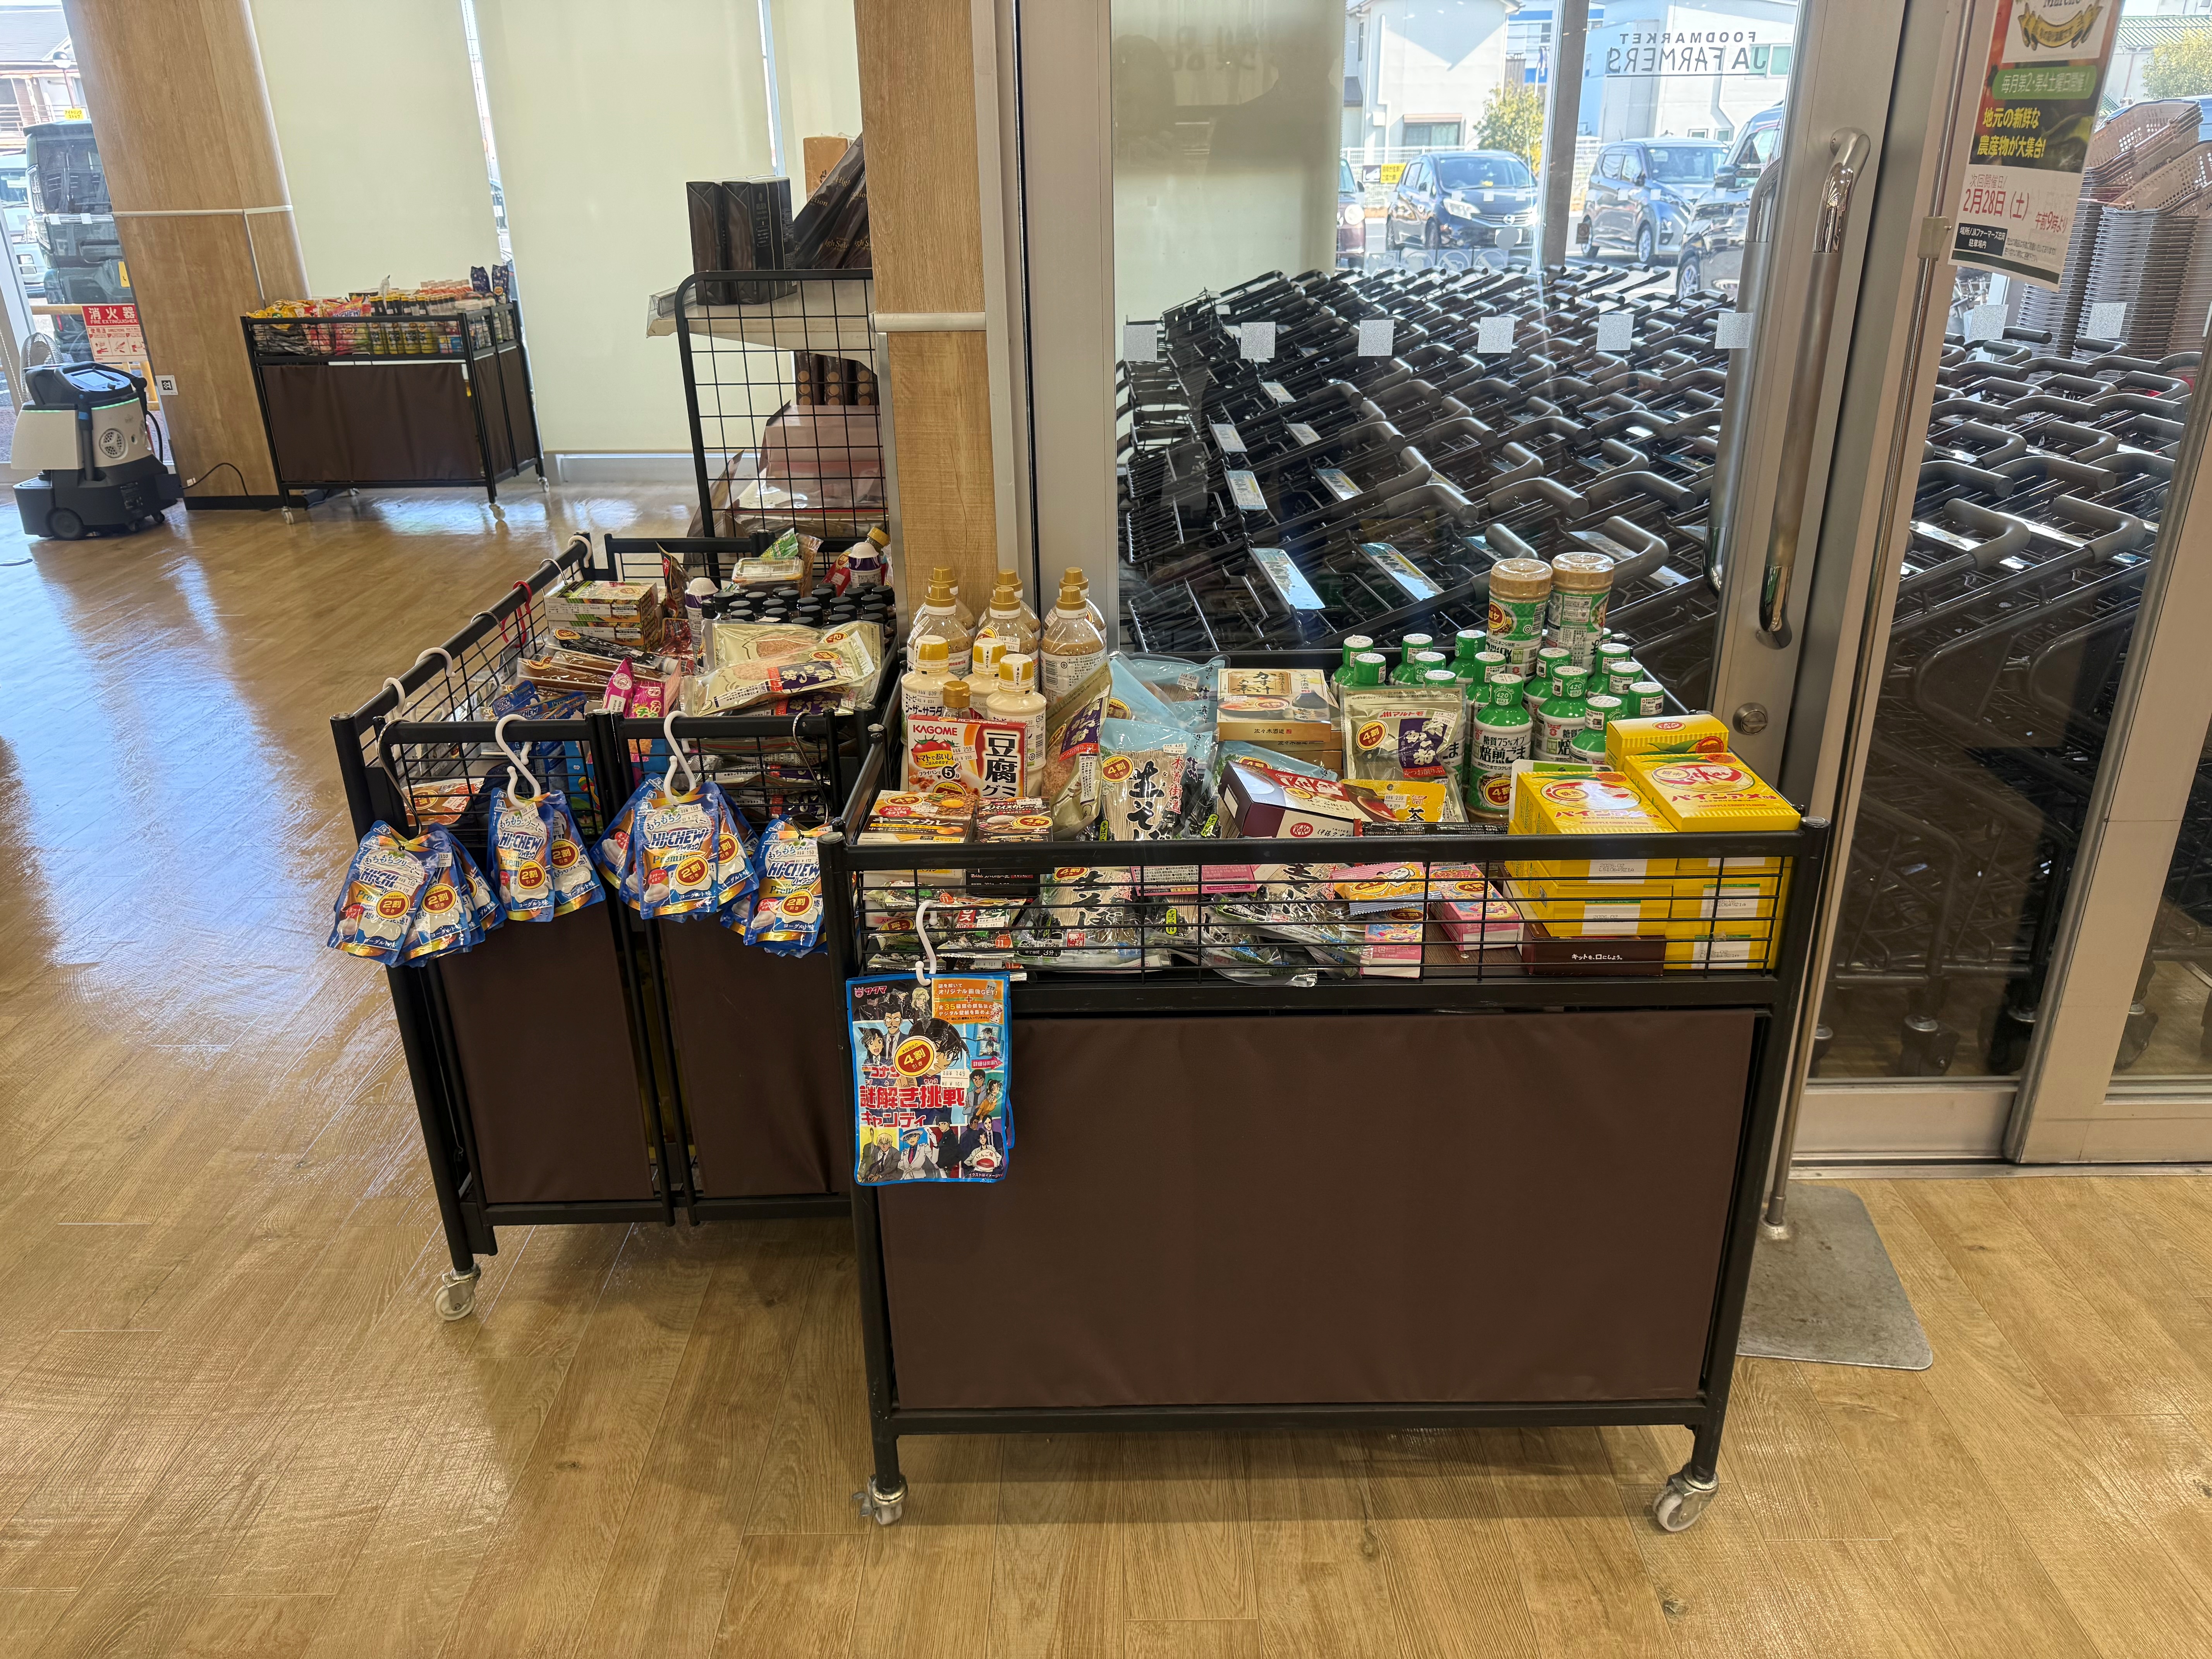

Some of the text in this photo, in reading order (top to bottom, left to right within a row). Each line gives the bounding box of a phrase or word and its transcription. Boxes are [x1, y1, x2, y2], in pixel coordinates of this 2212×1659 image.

[1983, 107, 2040, 129] 地元の新鮮な
[1977, 136, 2047, 158] 農産物が大集合!
[89, 307, 135, 320] 消火器
[913, 725, 958, 736] KAGOME
[1363, 728, 1379, 741] 4割
[1484, 735, 1527, 747] 糖質75%オフ
[1480, 747, 1528, 764] 焙煎ごま
[1108, 762, 1126, 774] 4割
[1285, 776, 1334, 793] KitKat
[1492, 788, 1510, 796] 4割
[873, 817, 963, 826] キーマカレー
[1294, 825, 1310, 833] KitKat
[500, 832, 543, 852] HI-CHEW
[650, 829, 709, 848] HI-CHEW
[553, 848, 571, 860] 2割
[522, 870, 538, 880] 2割
[681, 862, 701, 879] 2割
[383, 900, 402, 908] 2割
[428, 892, 449, 905] 2割
[787, 898, 805, 906] 2割
[903, 1051, 927, 1066] 4割
[912, 1061, 923, 1070] 引き
[860, 1085, 965, 1109] 謎解き挑戦
[861, 1112, 926, 1128] キャンディ
